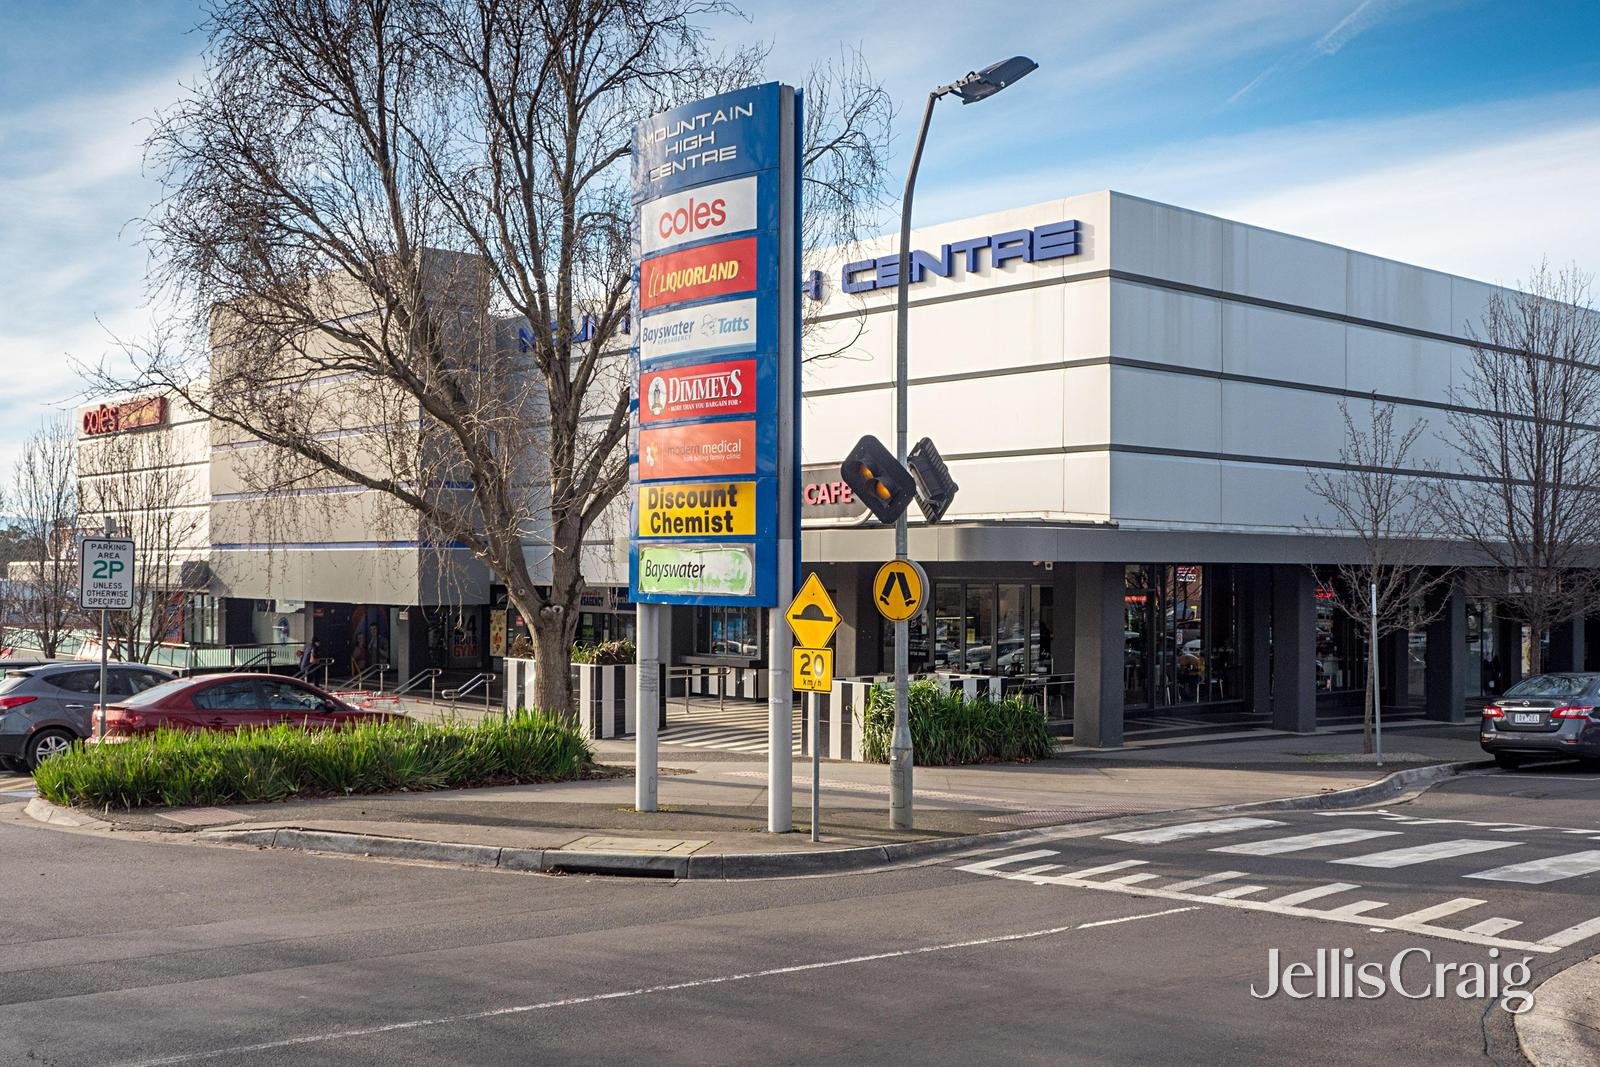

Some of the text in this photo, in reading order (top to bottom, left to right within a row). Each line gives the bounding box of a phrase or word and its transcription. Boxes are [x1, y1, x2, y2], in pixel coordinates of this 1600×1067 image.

[643, 103, 753, 146] MOUNTAIN
[665, 131, 715, 157] HIGH
[649, 146, 737, 182] CENTRE
[659, 198, 727, 240] coles
[842, 219, 1080, 294] CENTRE
[660, 260, 739, 293] LIQUORLAND
[642, 320, 695, 344] Bayswater
[718, 317, 750, 334] Tatts
[668, 369, 743, 404] DIMMEYS
[705, 400, 727, 408] BARGAIN
[83, 404, 118, 434] coles
[668, 439, 742, 457] modern medical
[648, 484, 737, 510] Discount
[804, 481, 853, 505] CAFE
[650, 510, 734, 534] Chemist
[92, 560, 124, 579] 2P
[645, 559, 706, 582] Bayswater
[453, 645, 478, 657] GYM
[800, 653, 825, 677] 20
[803, 678, 822, 688] km/h
